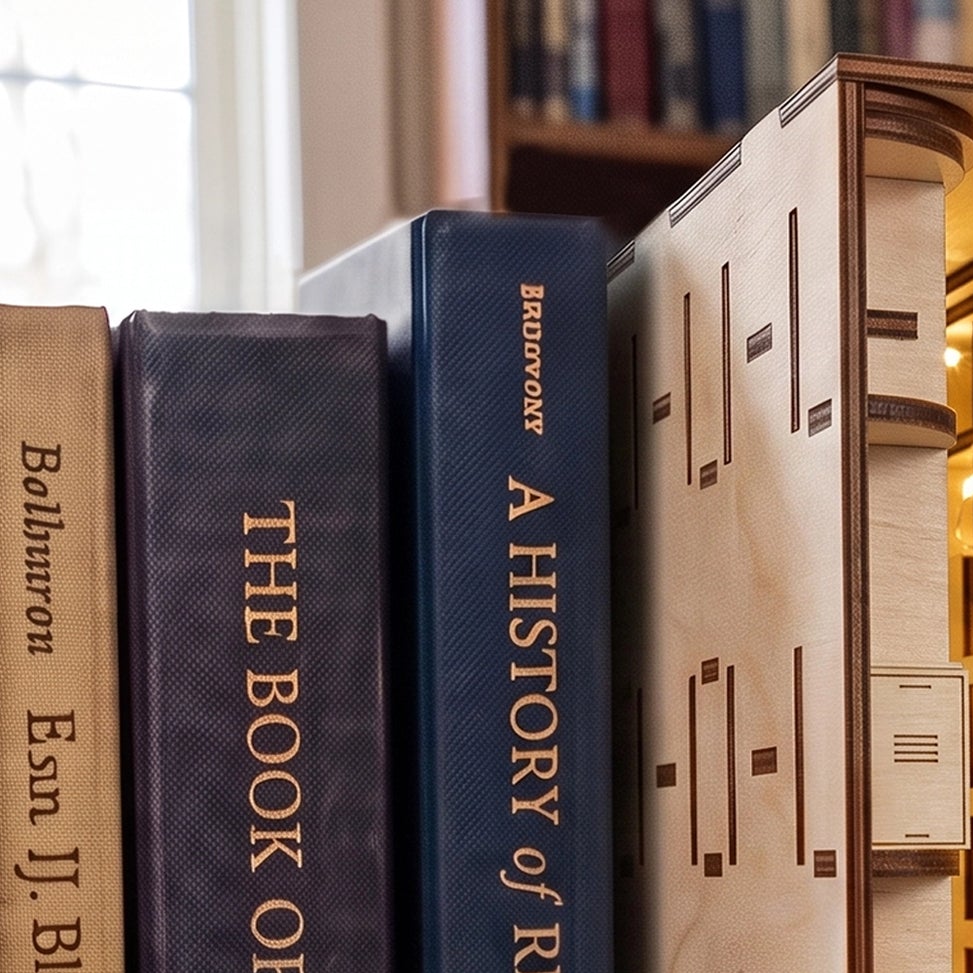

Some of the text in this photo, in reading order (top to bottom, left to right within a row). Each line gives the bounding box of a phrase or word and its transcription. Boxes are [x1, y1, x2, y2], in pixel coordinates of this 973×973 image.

[509, 476, 553, 520] A
[244, 501, 297, 643] THE
[509, 543, 558, 825] HISTORY
[247, 670, 302, 872] BOOK
[500, 848, 563, 906] of
